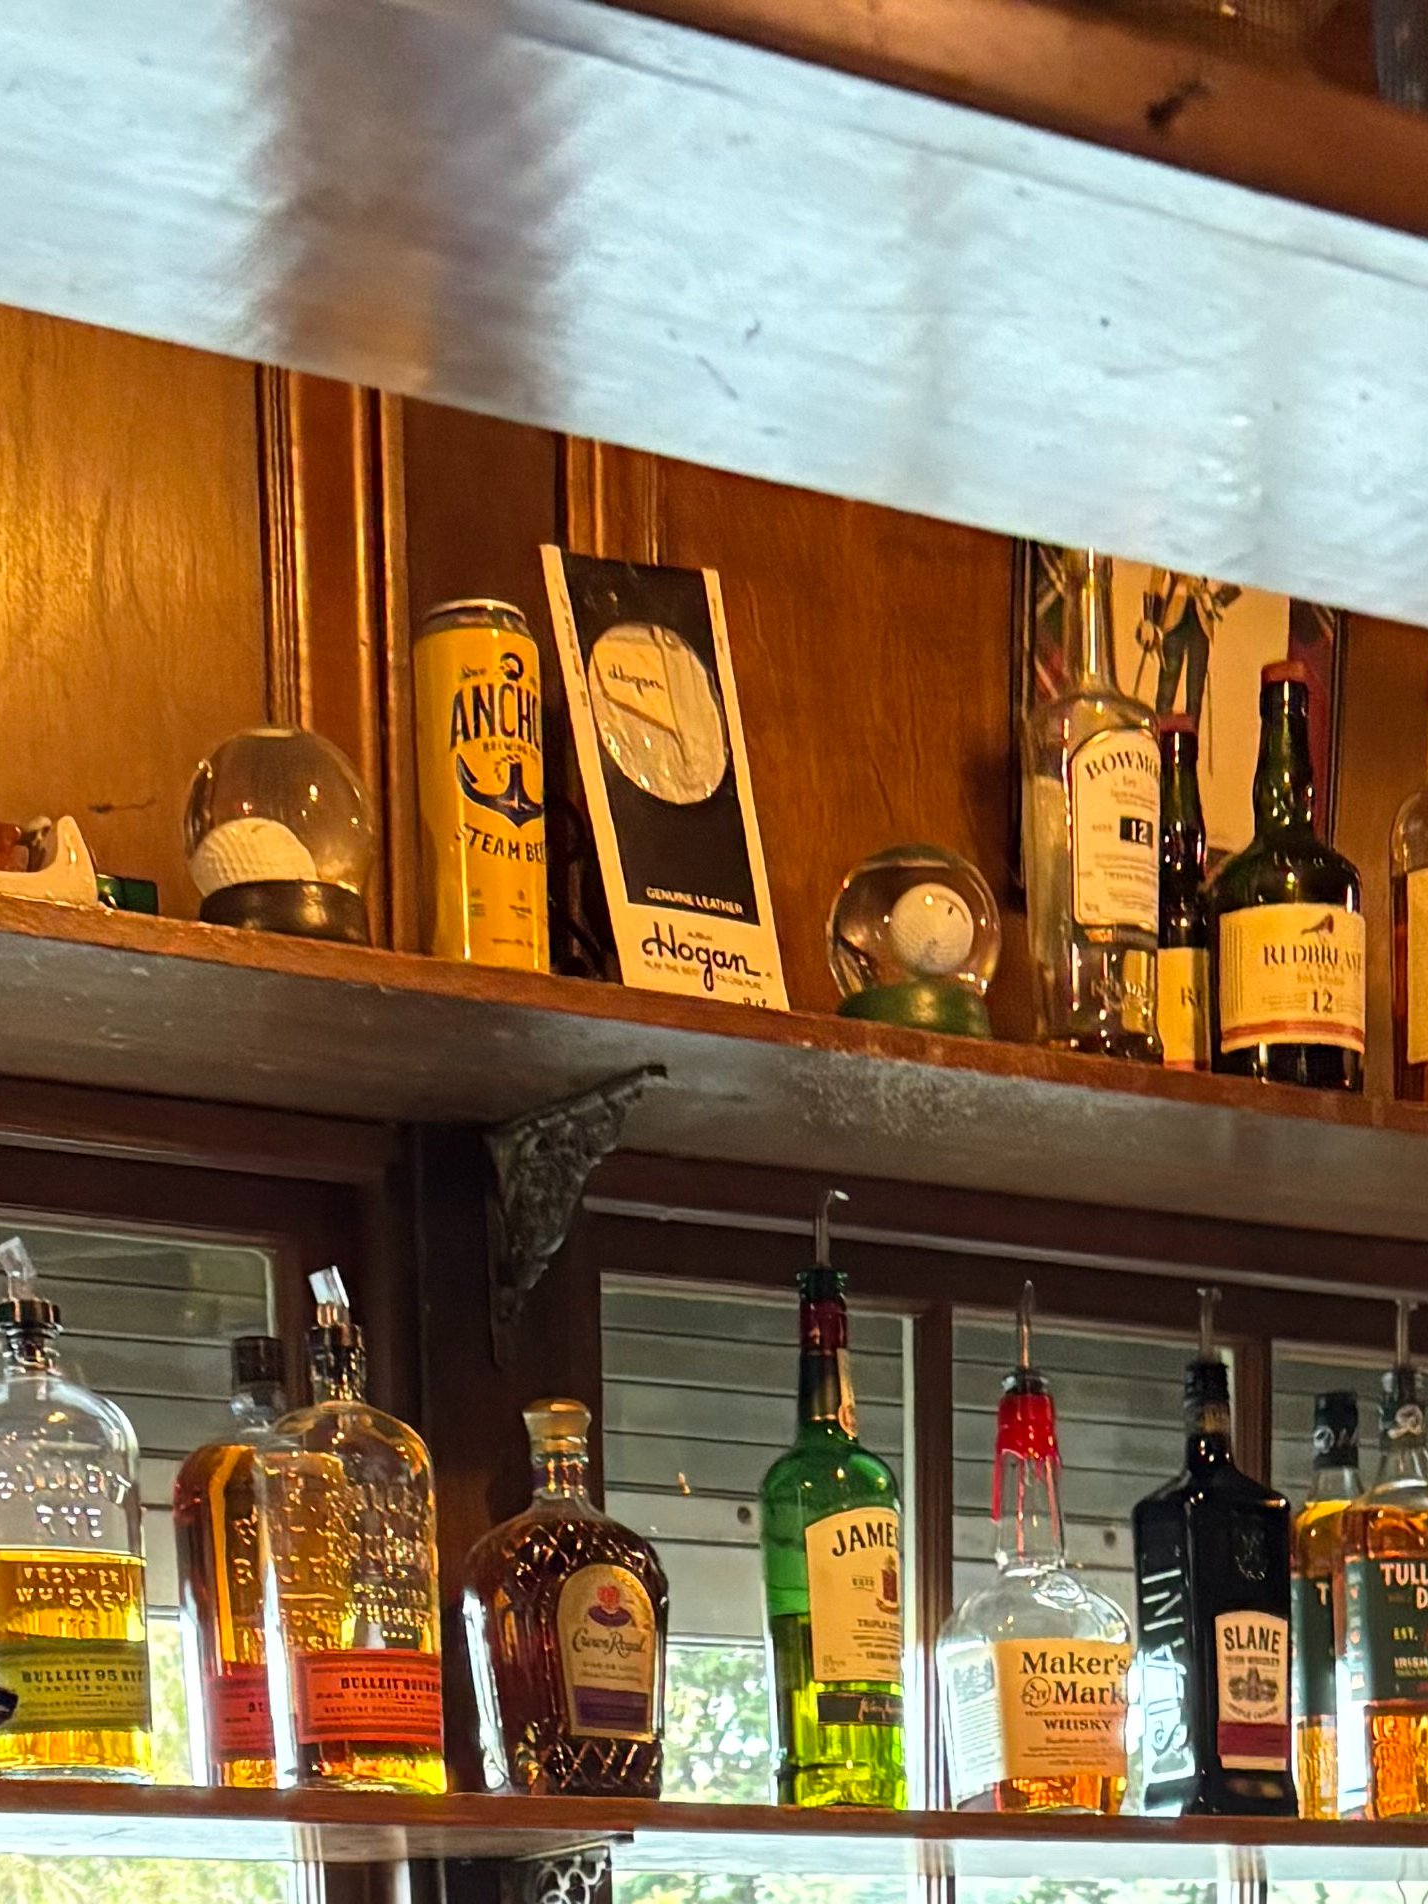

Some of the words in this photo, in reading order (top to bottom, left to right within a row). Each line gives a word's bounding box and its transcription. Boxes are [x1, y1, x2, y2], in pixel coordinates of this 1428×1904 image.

[1130, 820, 1149, 844] 12
[641, 921, 761, 992] Hogan
[1312, 988, 1334, 1014] 12
[1223, 1625, 1281, 1654] SLANE
[95, 1668, 118, 1683] 95
[1019, 1650, 1128, 1676] Maker's
[1394, 1656, 1428, 1670] IRISH
[1042, 1718, 1112, 1732] WHISKY
